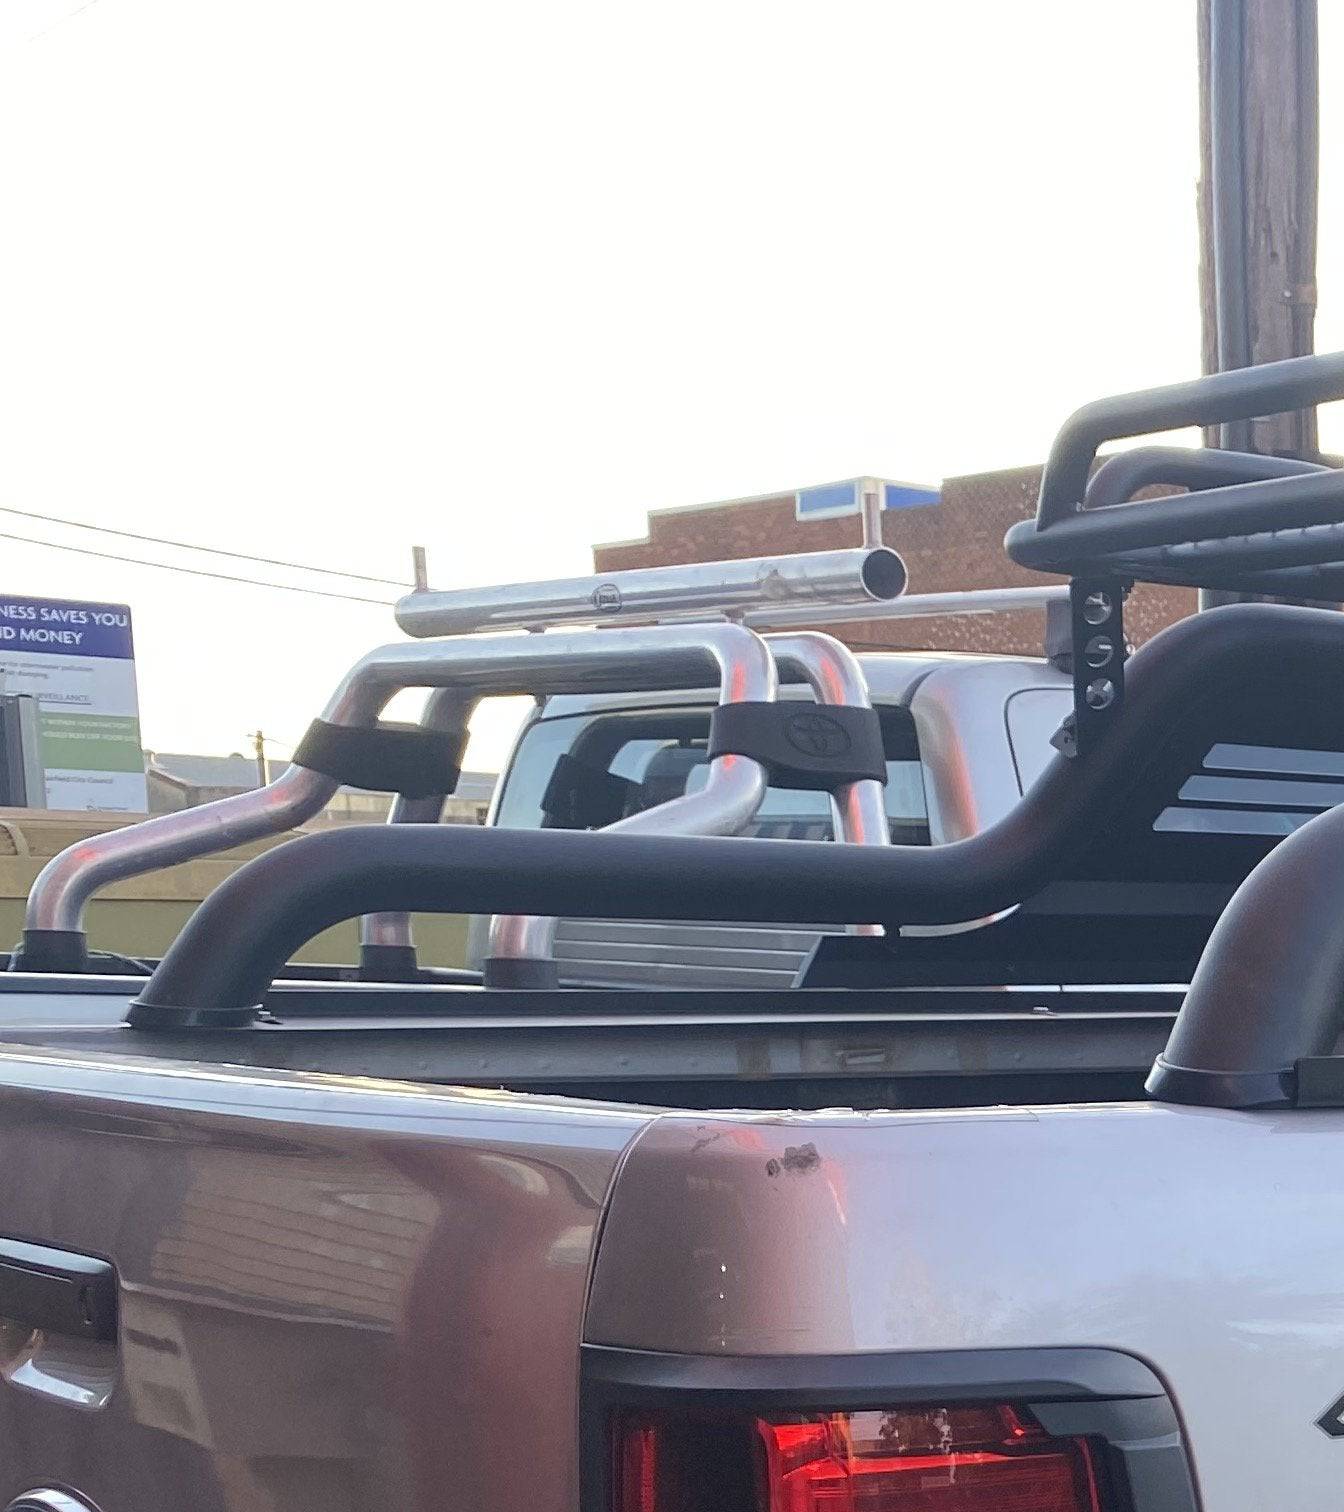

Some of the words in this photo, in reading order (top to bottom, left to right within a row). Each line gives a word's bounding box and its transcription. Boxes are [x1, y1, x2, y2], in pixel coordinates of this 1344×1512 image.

[40, 608, 87, 624] SAVES
[91, 613, 128, 627] YOU
[20, 629, 82, 645] MONEY
